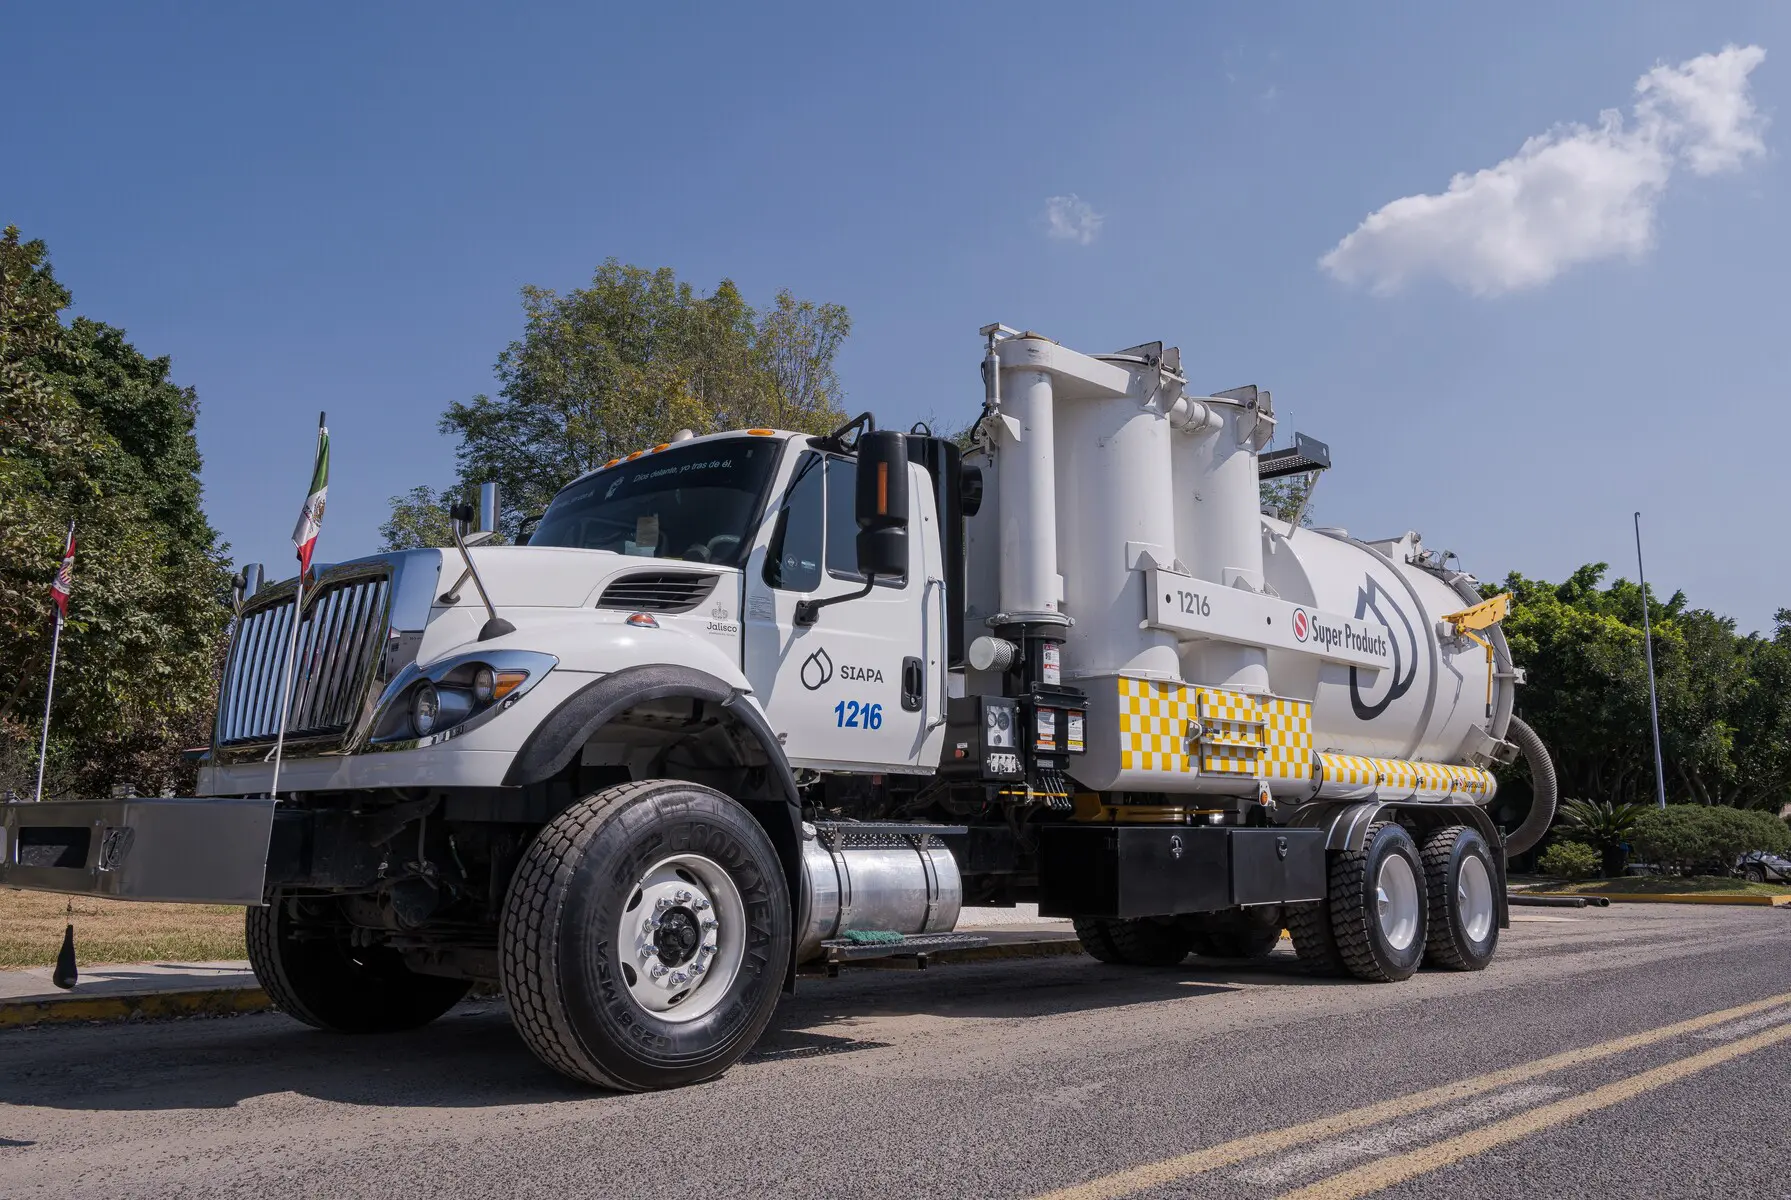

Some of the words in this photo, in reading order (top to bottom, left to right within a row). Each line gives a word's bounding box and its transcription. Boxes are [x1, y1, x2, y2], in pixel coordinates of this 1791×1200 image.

[633, 473, 649, 483] Dios
[650, 467, 678, 478] delante,
[680, 464, 691, 474] yo
[692, 462, 707, 470] tras
[708, 460, 720, 469] de
[1177, 590, 1211, 617] 1216
[706, 621, 738, 632] Jalisco
[1311, 615, 1343, 653] Super
[1344, 623, 1387, 657] Products
[840, 665, 884, 684] SIAPA
[834, 700, 883, 730] 1216
